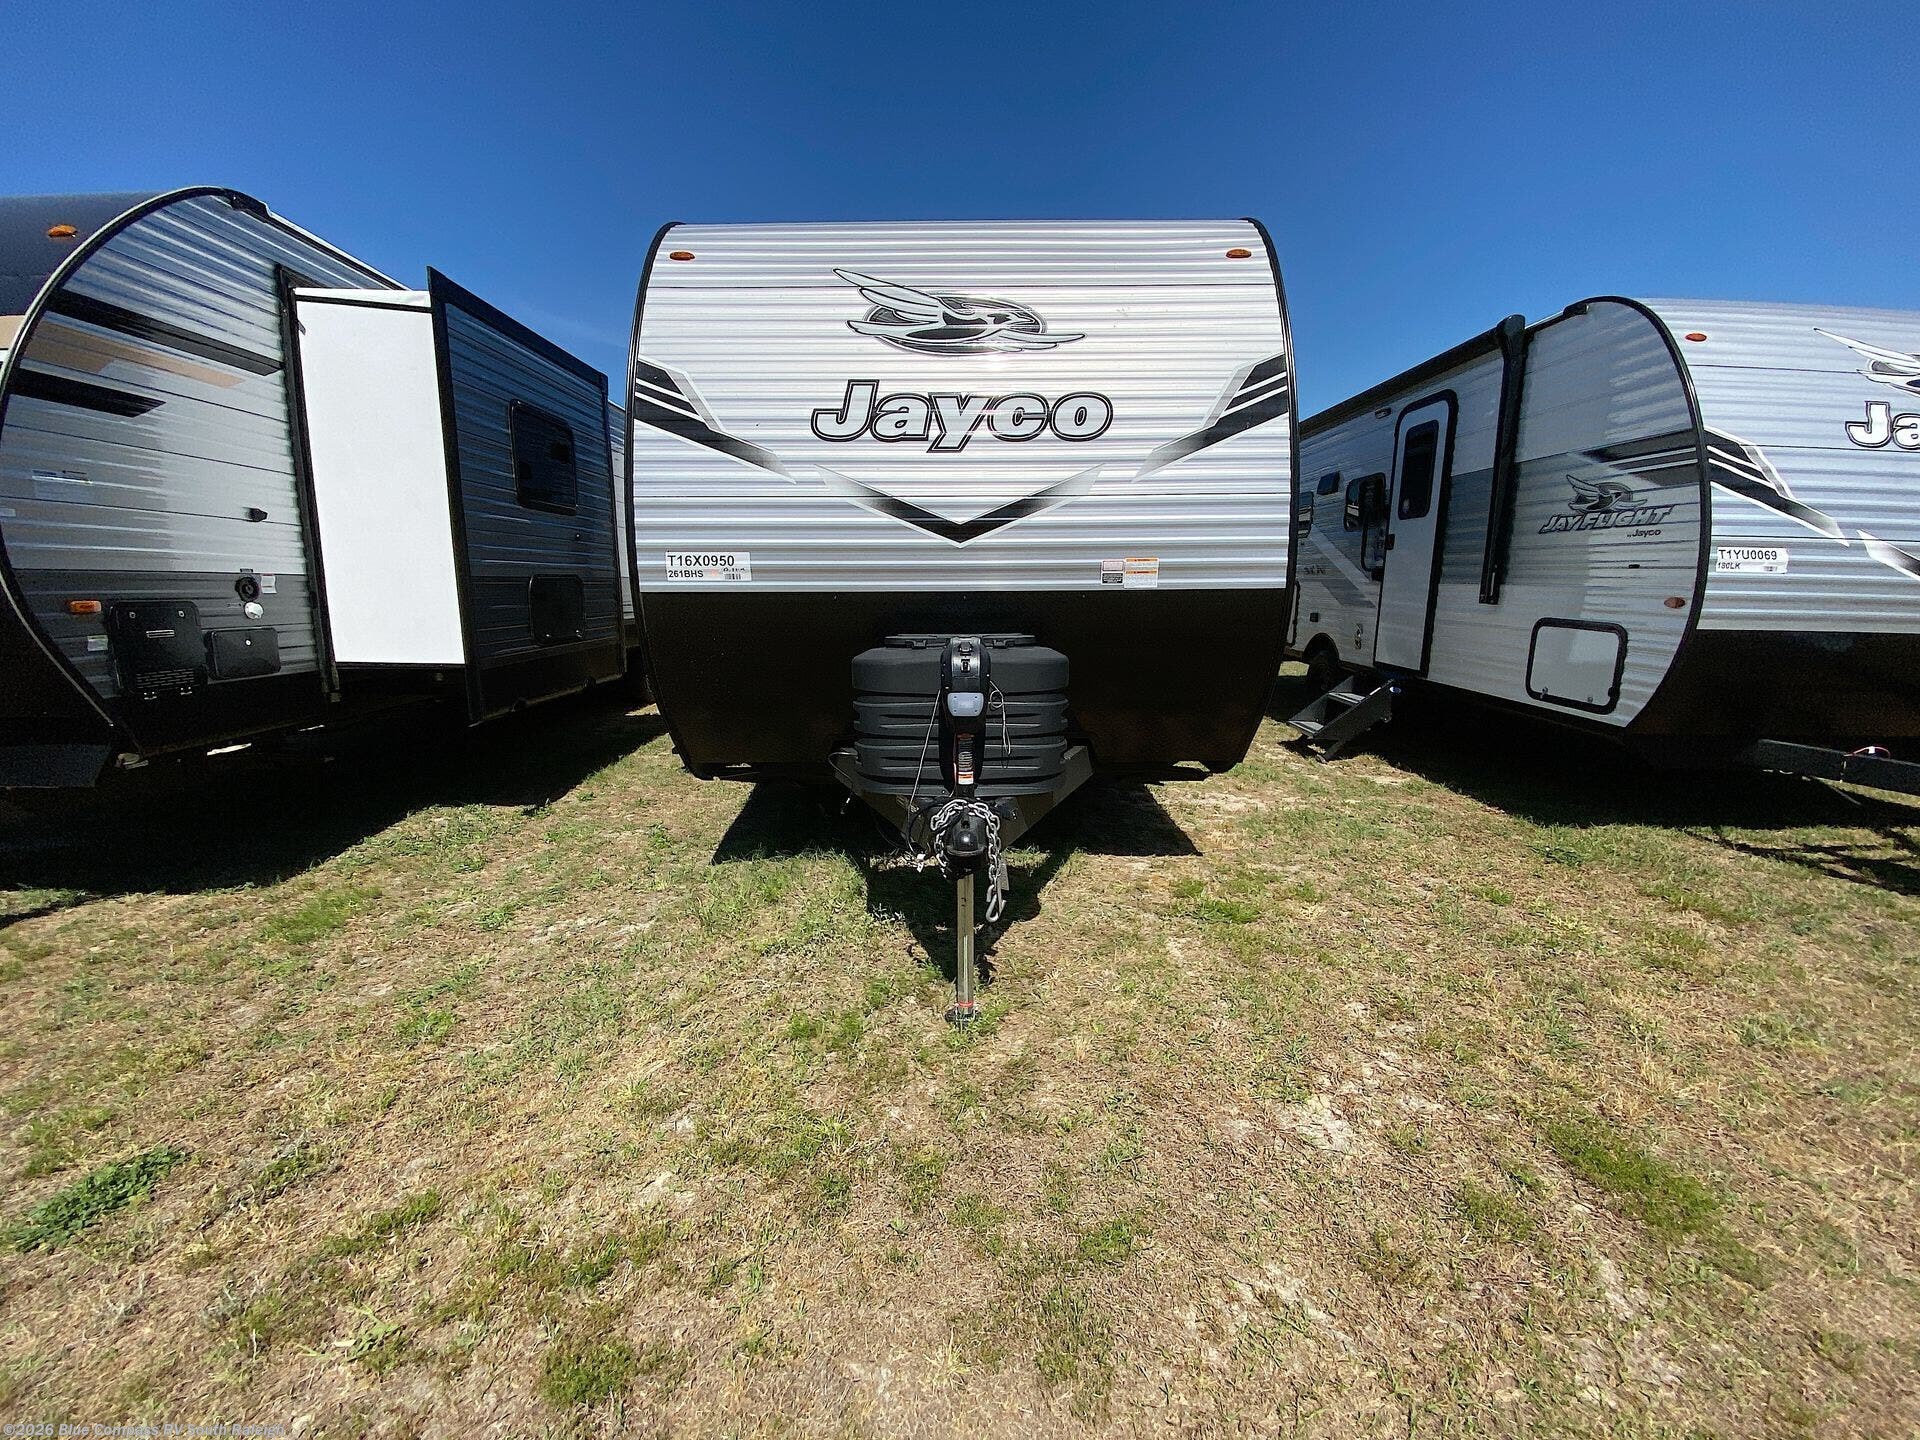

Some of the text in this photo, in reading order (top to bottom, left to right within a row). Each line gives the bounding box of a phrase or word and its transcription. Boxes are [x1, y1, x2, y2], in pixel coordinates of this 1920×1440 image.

[811, 379, 1113, 453] Jayco
[1632, 528, 1662, 538] Jayco
[1718, 549, 1777, 560] T1YU0069
[667, 555, 735, 566] T16X0950
[668, 570, 704, 578] 261BHS
